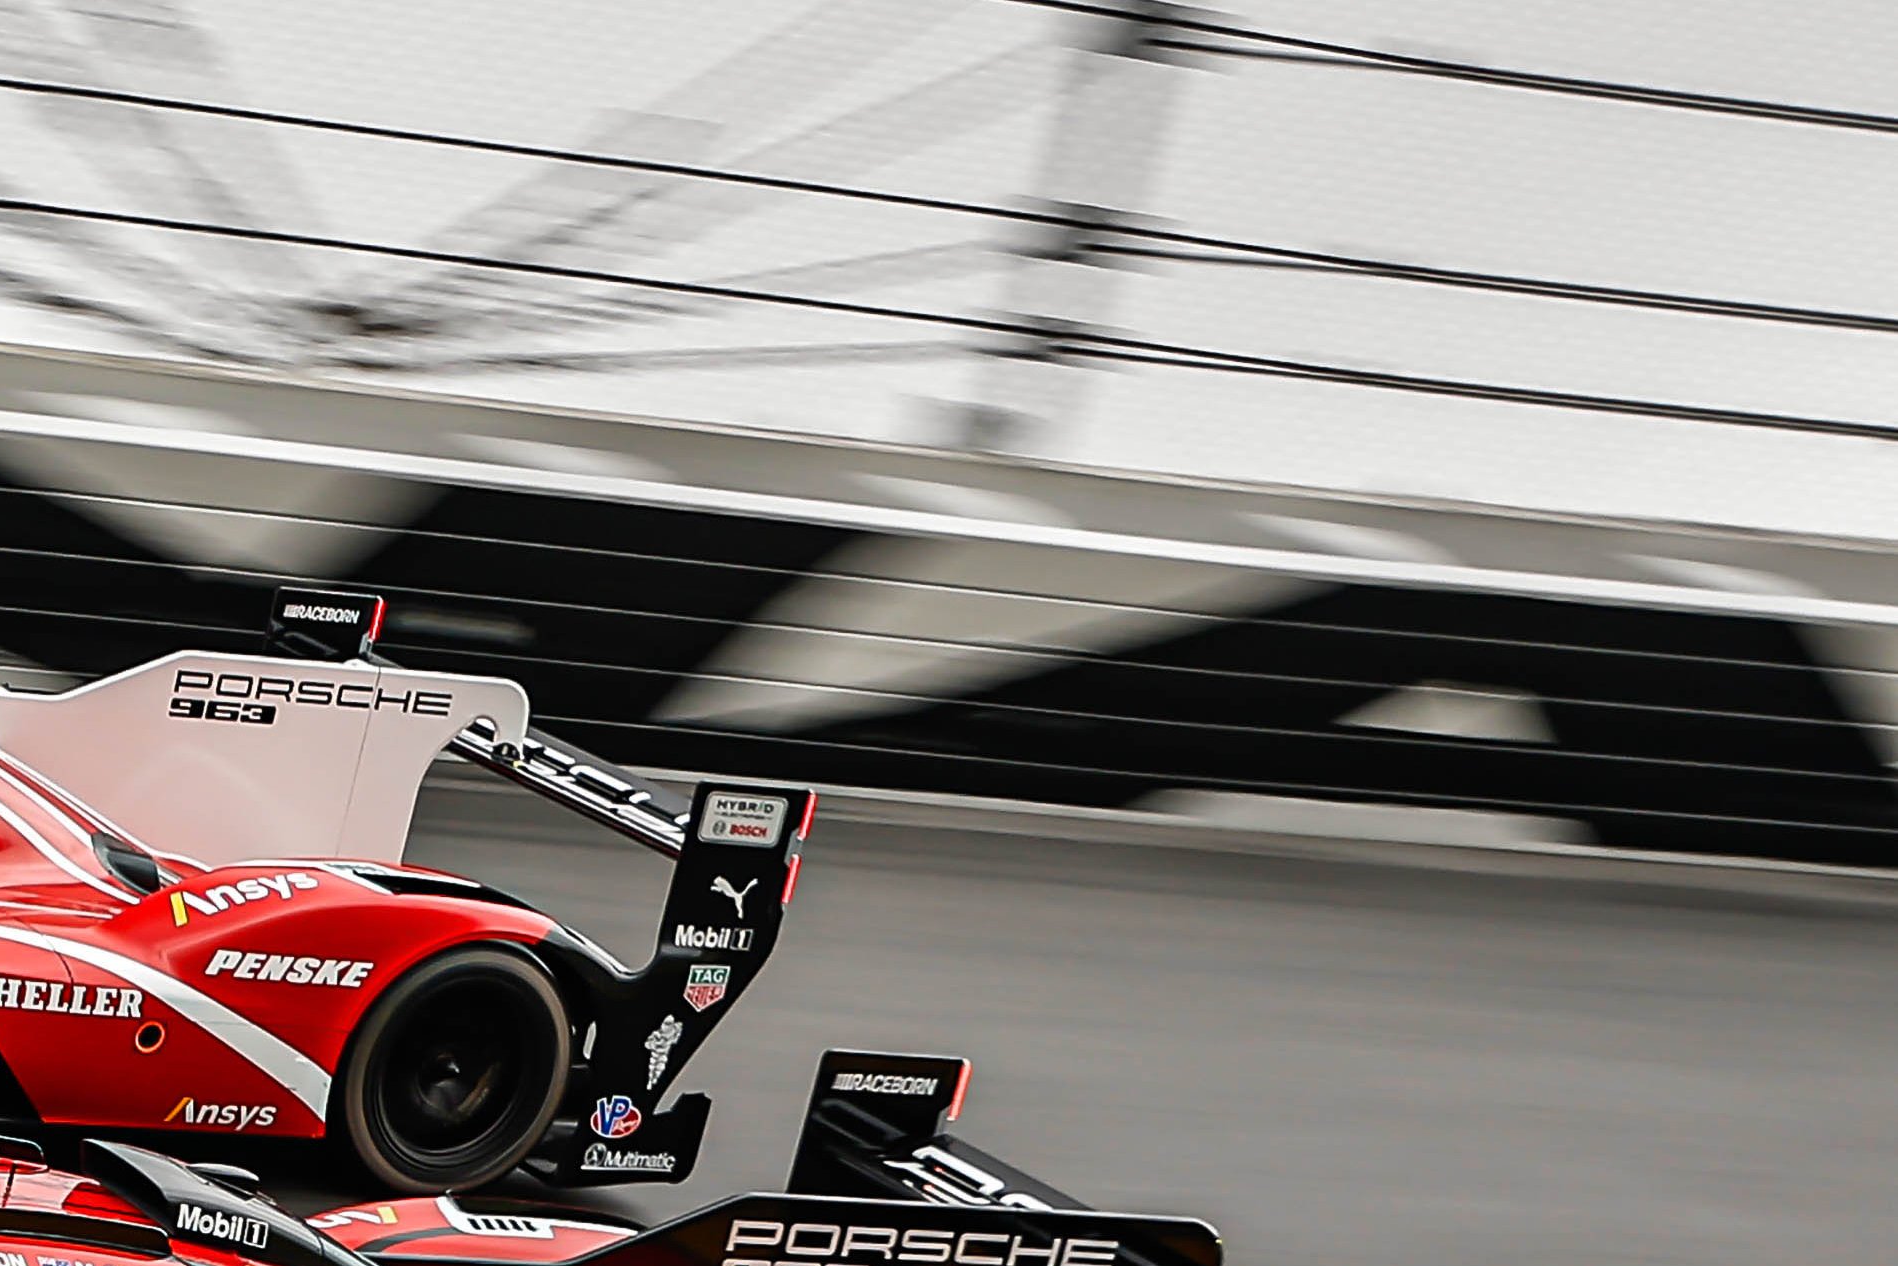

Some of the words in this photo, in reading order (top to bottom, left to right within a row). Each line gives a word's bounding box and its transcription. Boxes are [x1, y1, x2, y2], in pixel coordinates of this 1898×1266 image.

[294, 604, 360, 625] RACEBORN
[173, 669, 453, 717] PORSCHE
[168, 699, 277, 725] 963
[728, 823, 768, 838] BOSCH
[169, 871, 319, 927] Ansys
[675, 924, 730, 949] Mobil
[204, 949, 374, 988] PENSKE
[694, 968, 726, 984] TAG
[853, 1073, 938, 1096] RACEBORN
[163, 1097, 277, 1132] Ansys
[597, 1095, 632, 1137] VP
[177, 1203, 243, 1243] Mobil
